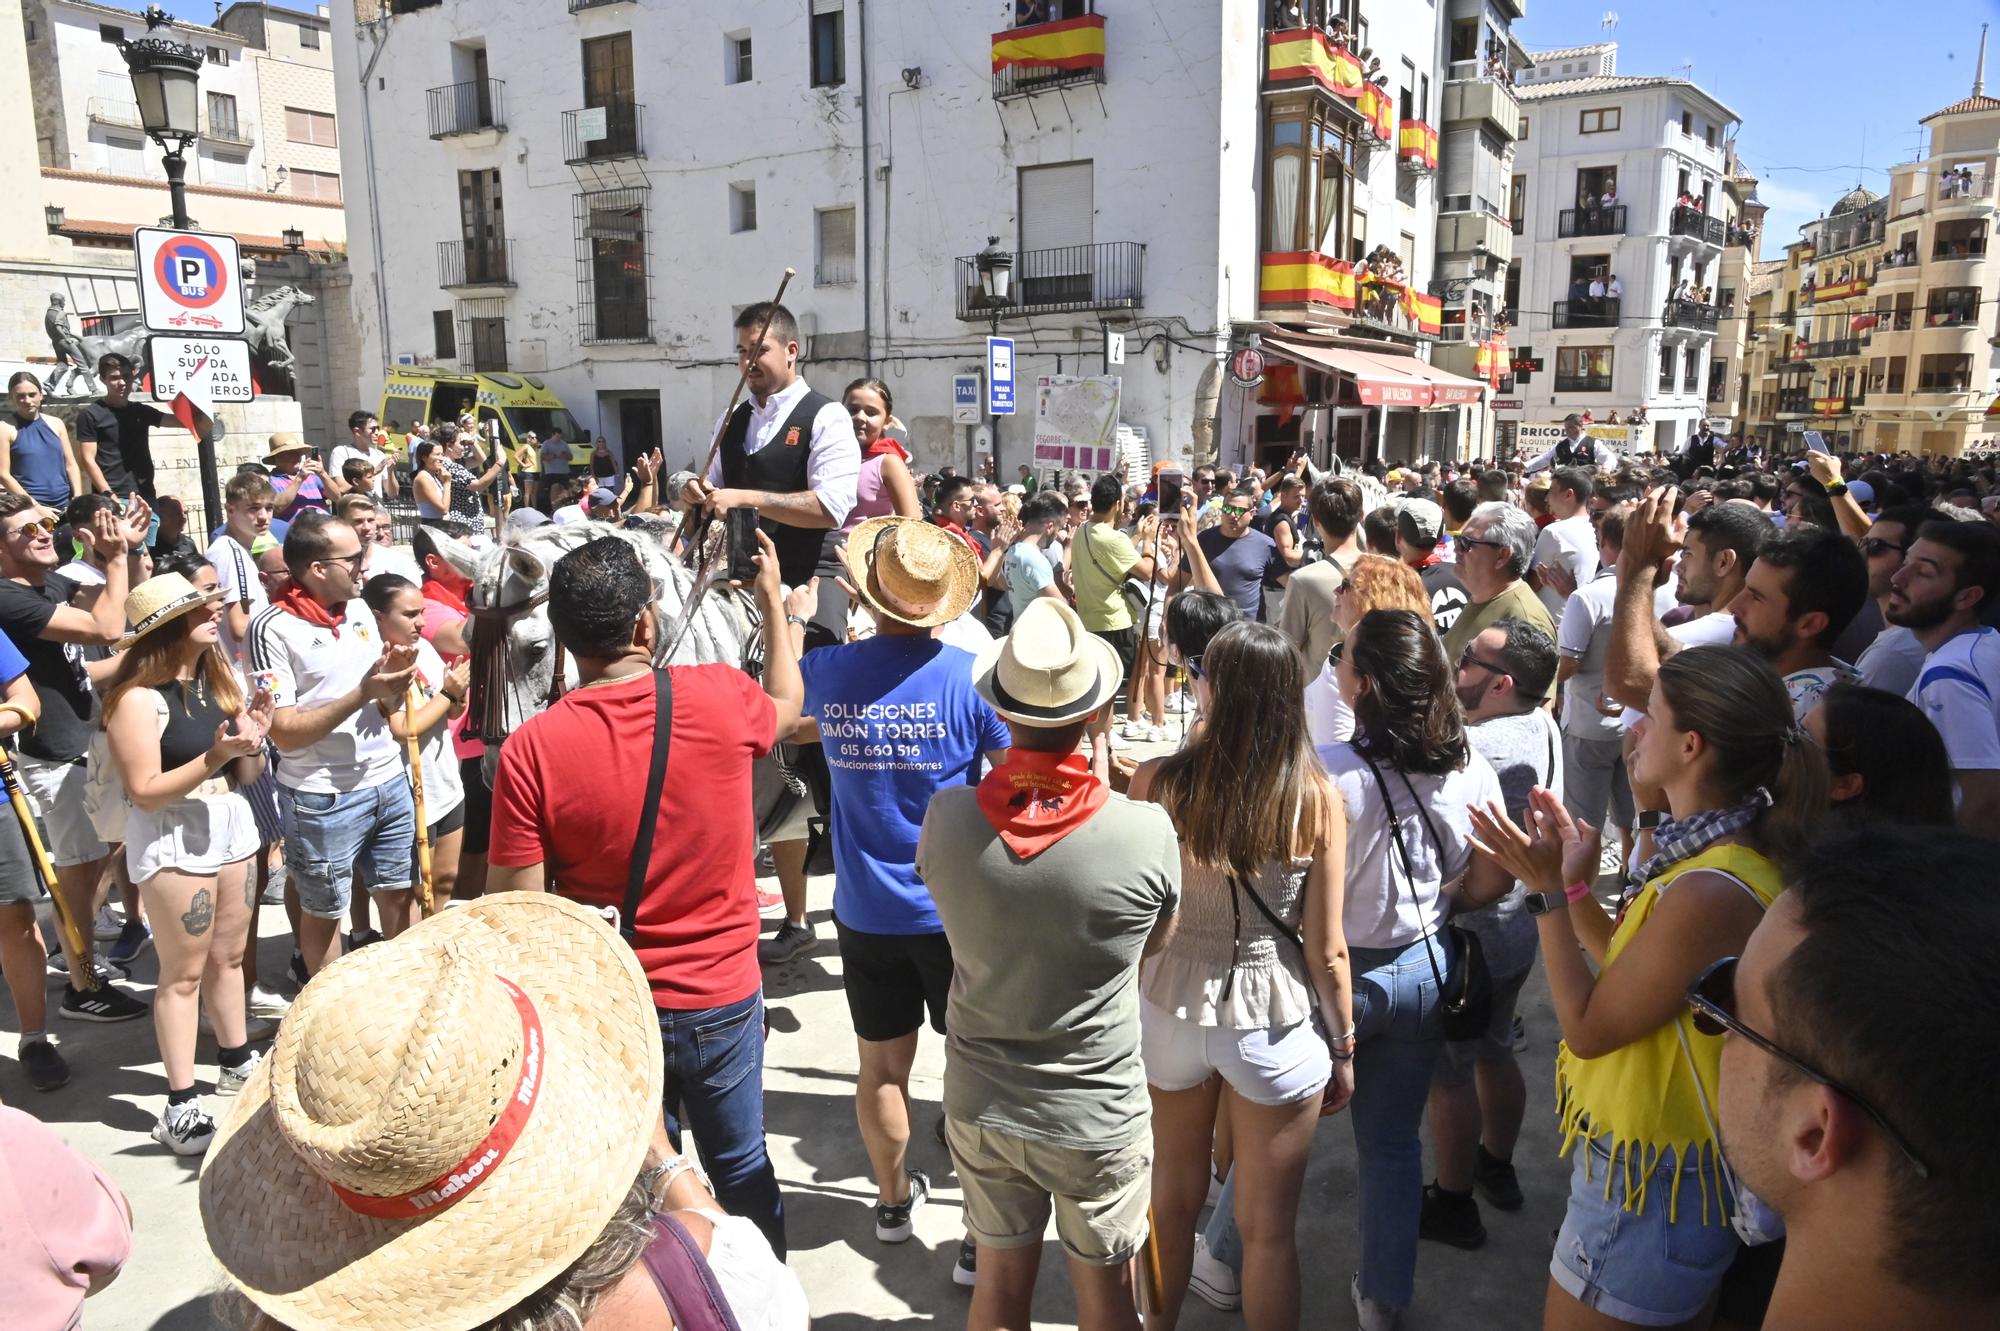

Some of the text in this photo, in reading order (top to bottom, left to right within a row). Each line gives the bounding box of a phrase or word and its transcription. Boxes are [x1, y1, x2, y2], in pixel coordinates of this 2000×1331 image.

[180, 260, 200, 284] P
[181, 286, 206, 296] BUS
[184, 343, 220, 354] SÓLO
[178, 358, 228, 368] SUDA
[168, 371, 238, 382] Y BADA
[158, 384, 176, 394] DE
[956, 386, 976, 396] TAXI
[1382, 386, 1392, 400] BAR
[1393, 387, 1412, 400] VALENCIA
[1520, 427, 1568, 436] BRICOD
[1036, 434, 1062, 444] SEGORBE
[236, 456, 249, 464] DE
[824, 702, 936, 720] SOLUCIONES
[821, 720, 946, 740] SIMÓN TORRES
[840, 744, 920, 756] 615 660 516
[408, 1148, 500, 1210] Mahou
